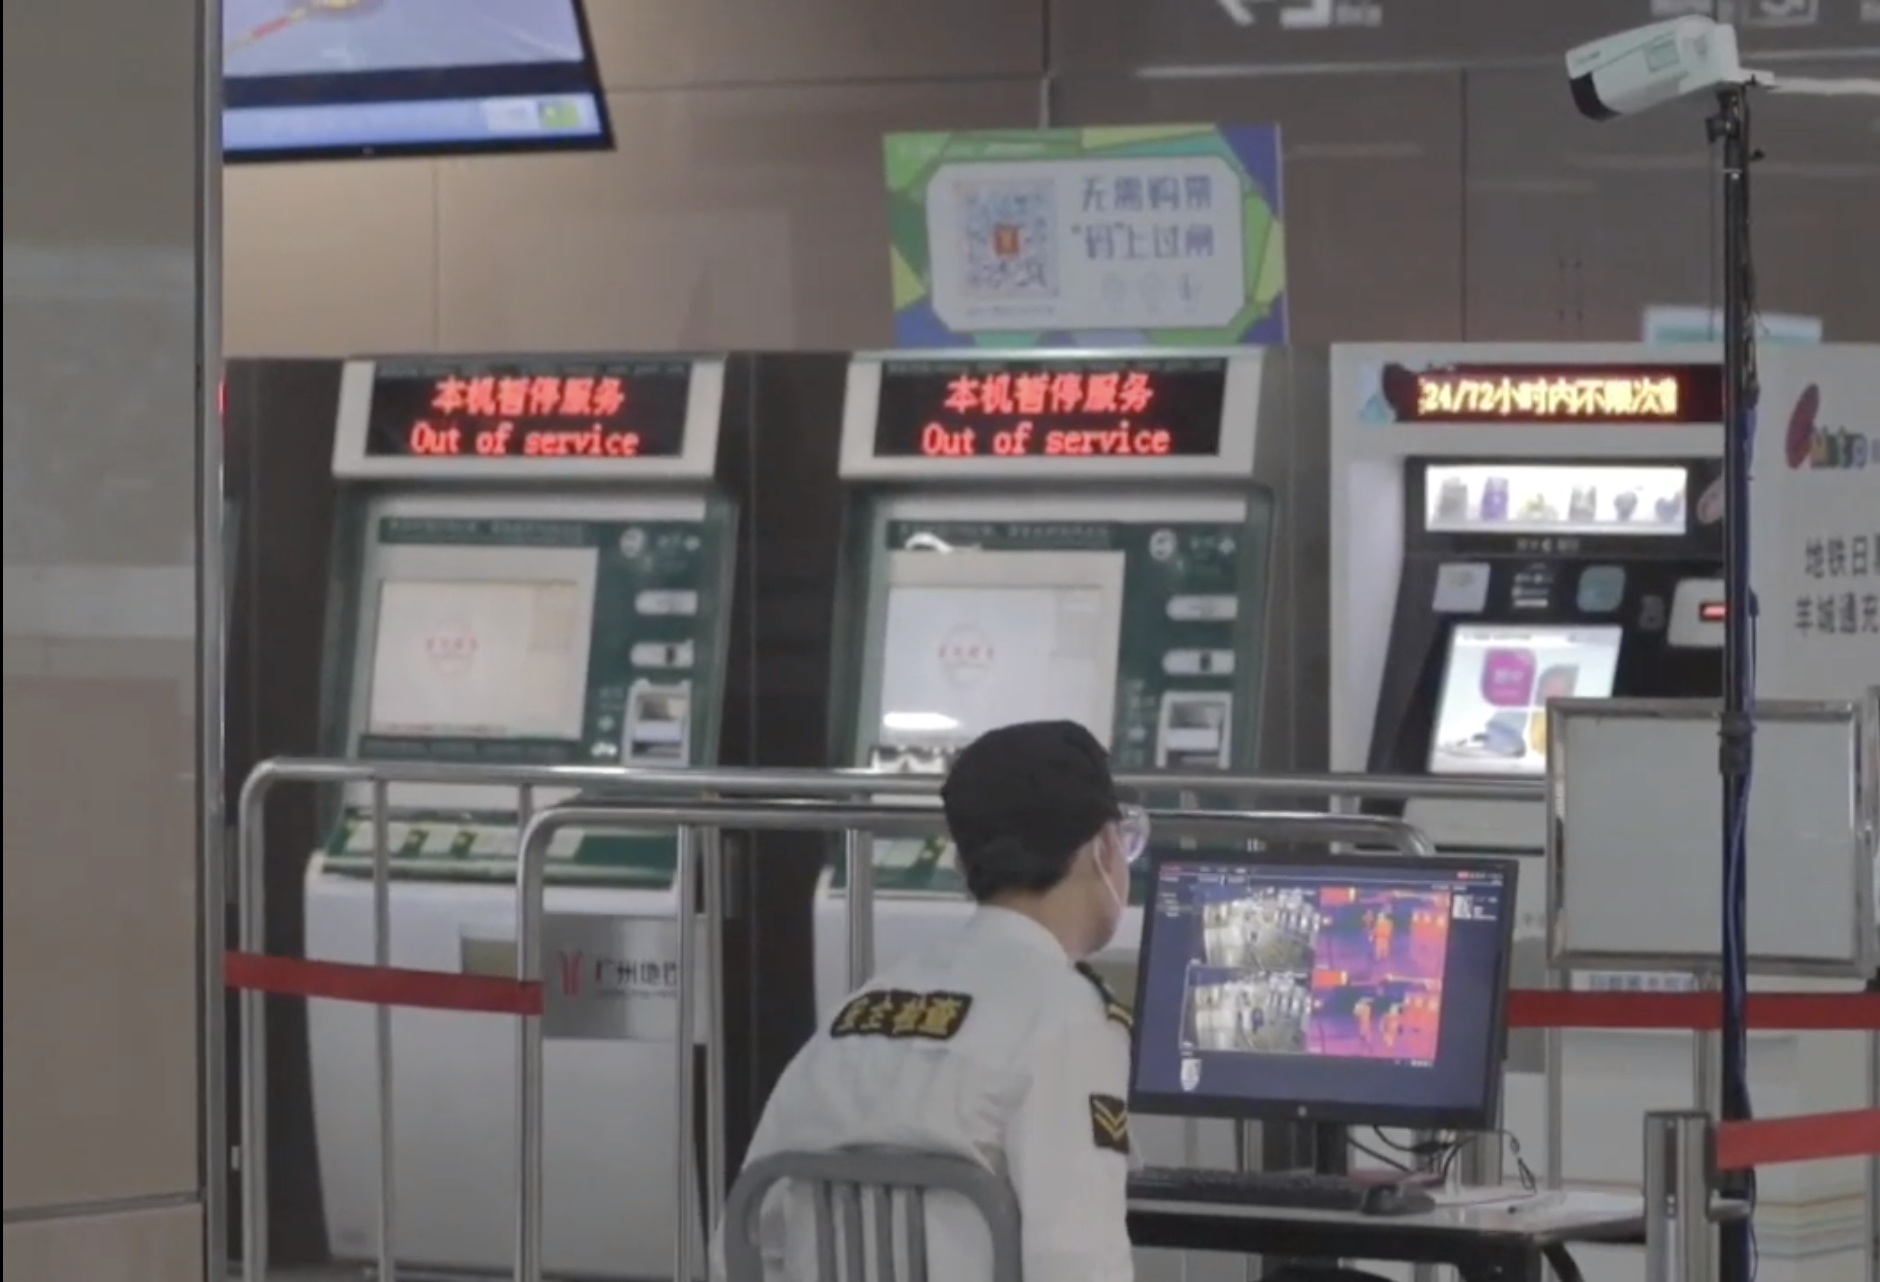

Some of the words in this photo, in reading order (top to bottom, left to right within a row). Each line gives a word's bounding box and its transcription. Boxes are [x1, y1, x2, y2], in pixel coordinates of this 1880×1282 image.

[432, 375, 625, 417] 本机暂停服务
[944, 371, 1154, 415] 本机暂停服务
[409, 421, 460, 456] Out
[475, 422, 516, 456] of
[524, 424, 640, 456] service
[921, 422, 975, 456] Out
[992, 421, 1033, 456] of
[1045, 420, 1171, 455] service
